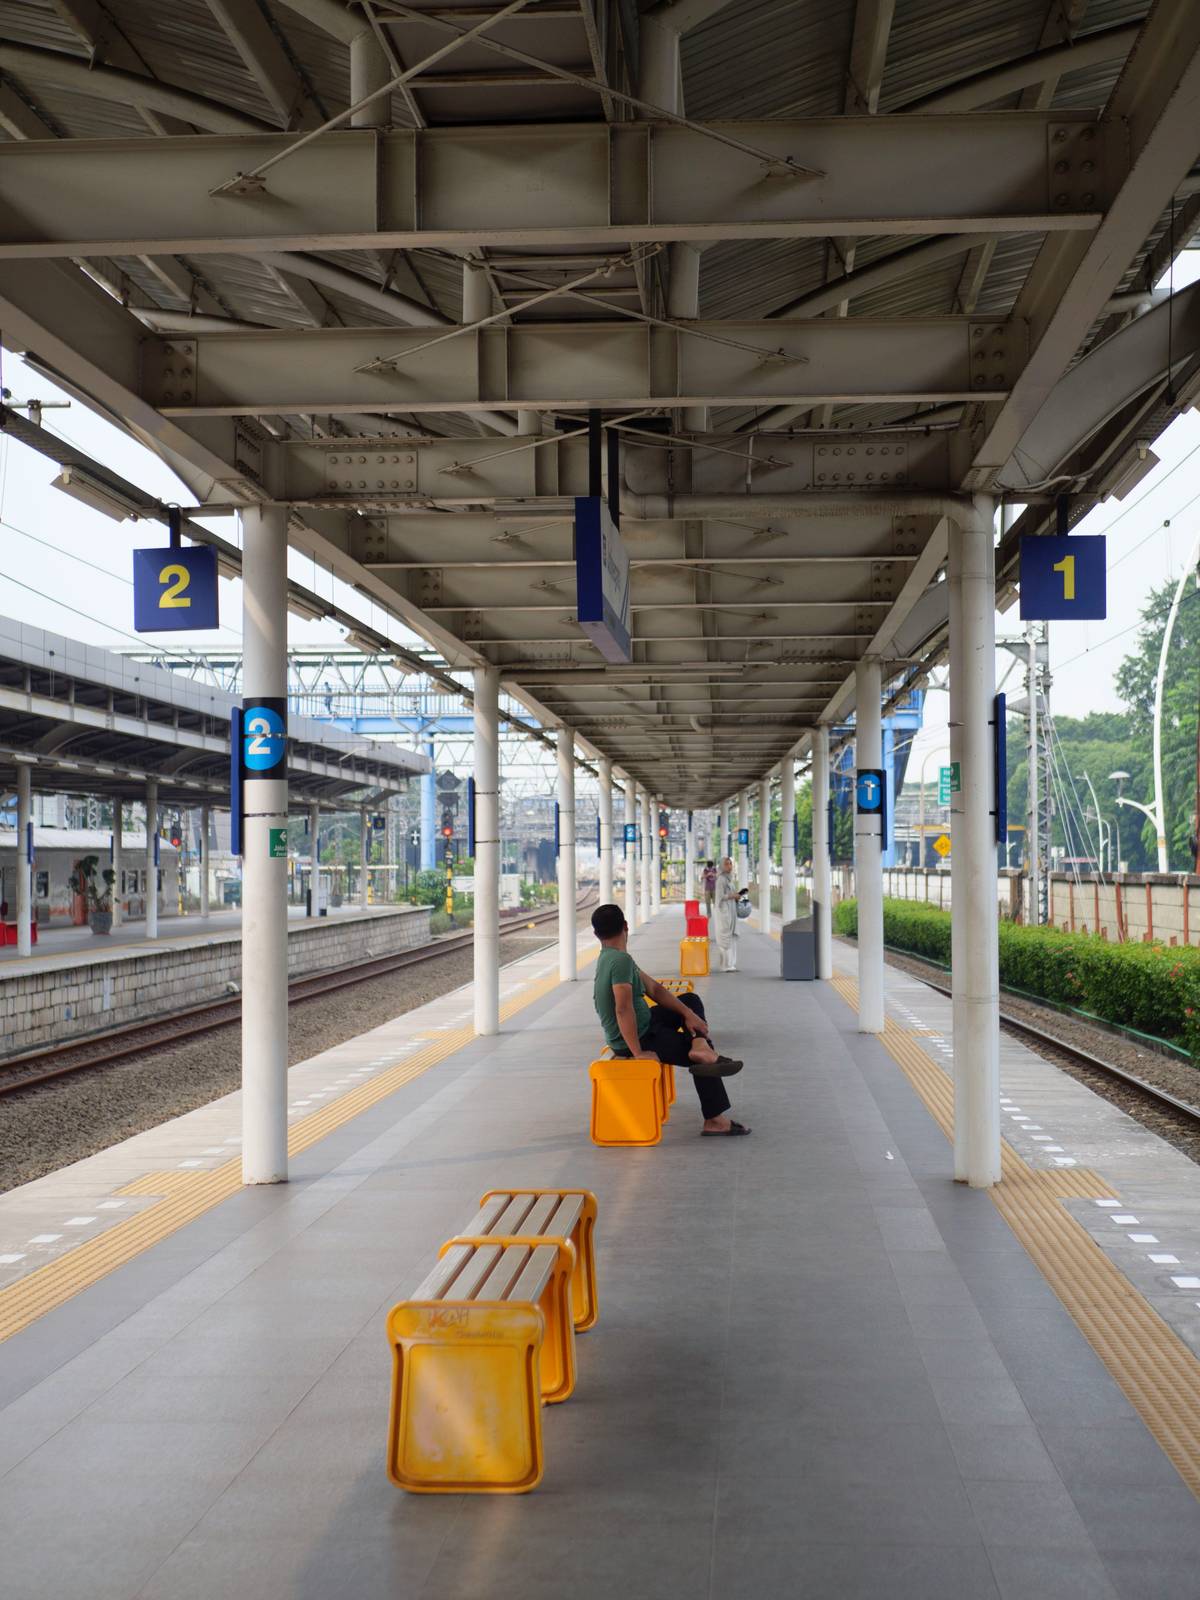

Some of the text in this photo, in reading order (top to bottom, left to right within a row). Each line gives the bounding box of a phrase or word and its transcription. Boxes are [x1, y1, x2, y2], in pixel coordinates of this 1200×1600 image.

[158, 564, 191, 609] 2
[1053, 555, 1075, 600] 1
[248, 717, 271, 755] 2
[864, 780, 873, 801] 1
